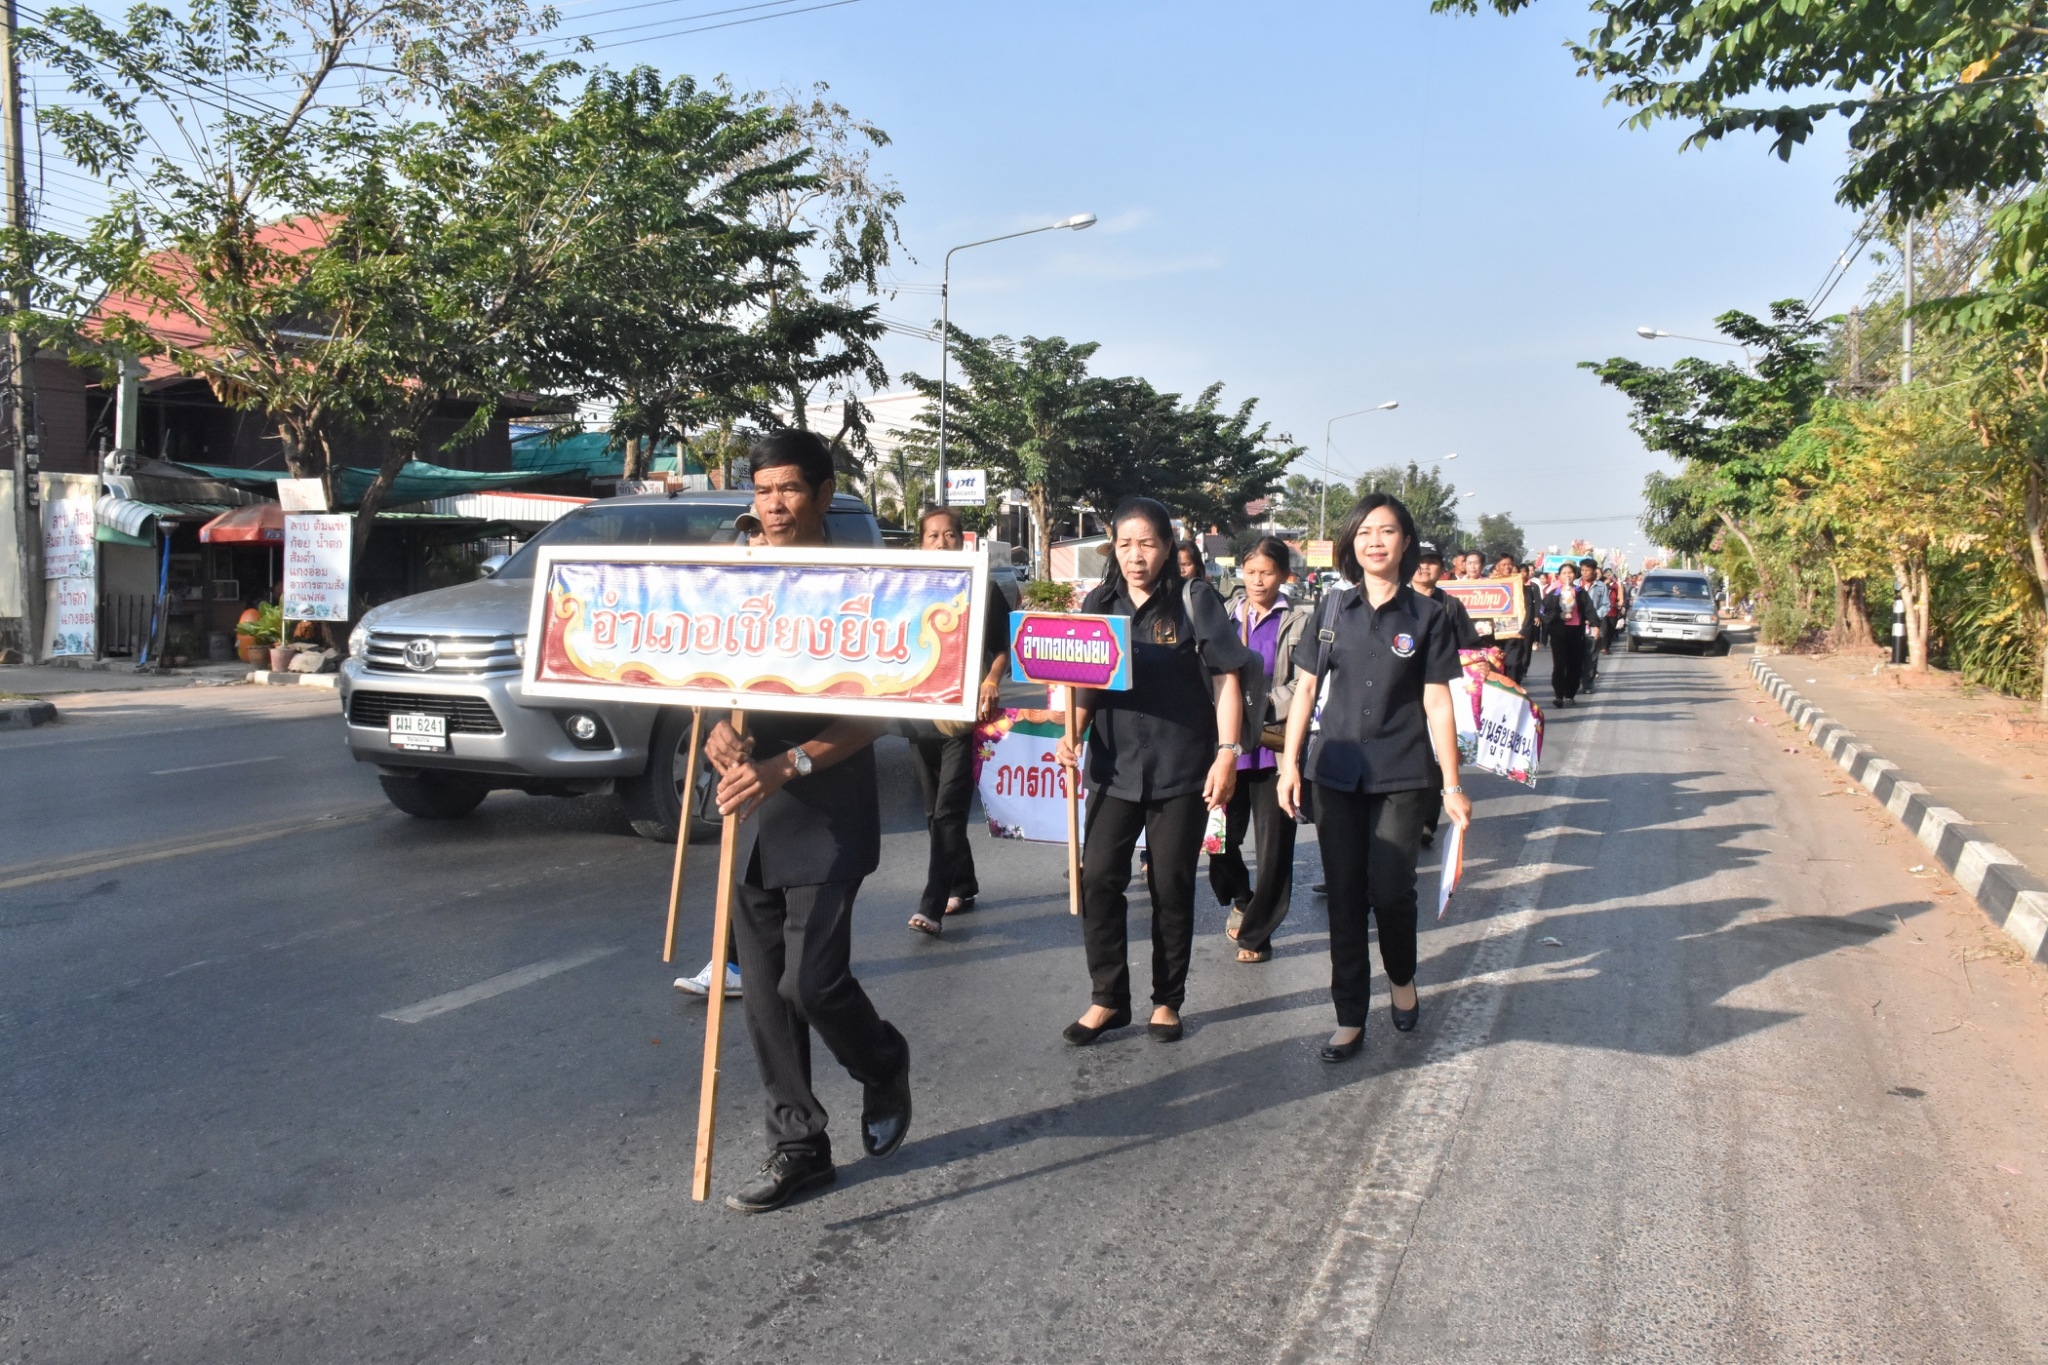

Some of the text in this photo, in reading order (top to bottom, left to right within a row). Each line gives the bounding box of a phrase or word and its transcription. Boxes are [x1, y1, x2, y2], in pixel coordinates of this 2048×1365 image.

[290, 522, 310, 532] ลาบ
[290, 533, 343, 549] ก้อย น้ำตก
[290, 551, 316, 564] ส้มตำ
[289, 565, 328, 577] แกงอ่อม
[289, 576, 345, 590] อาหารตามสั่ง
[58, 580, 87, 607] น้ำตก
[290, 592, 327, 603] กาแฟสด
[592, 590, 911, 664] อำเภอเชียงยืน
[1023, 625, 1110, 665] อำเภอเชียงยืน
[417, 718, 443, 733] 6241
